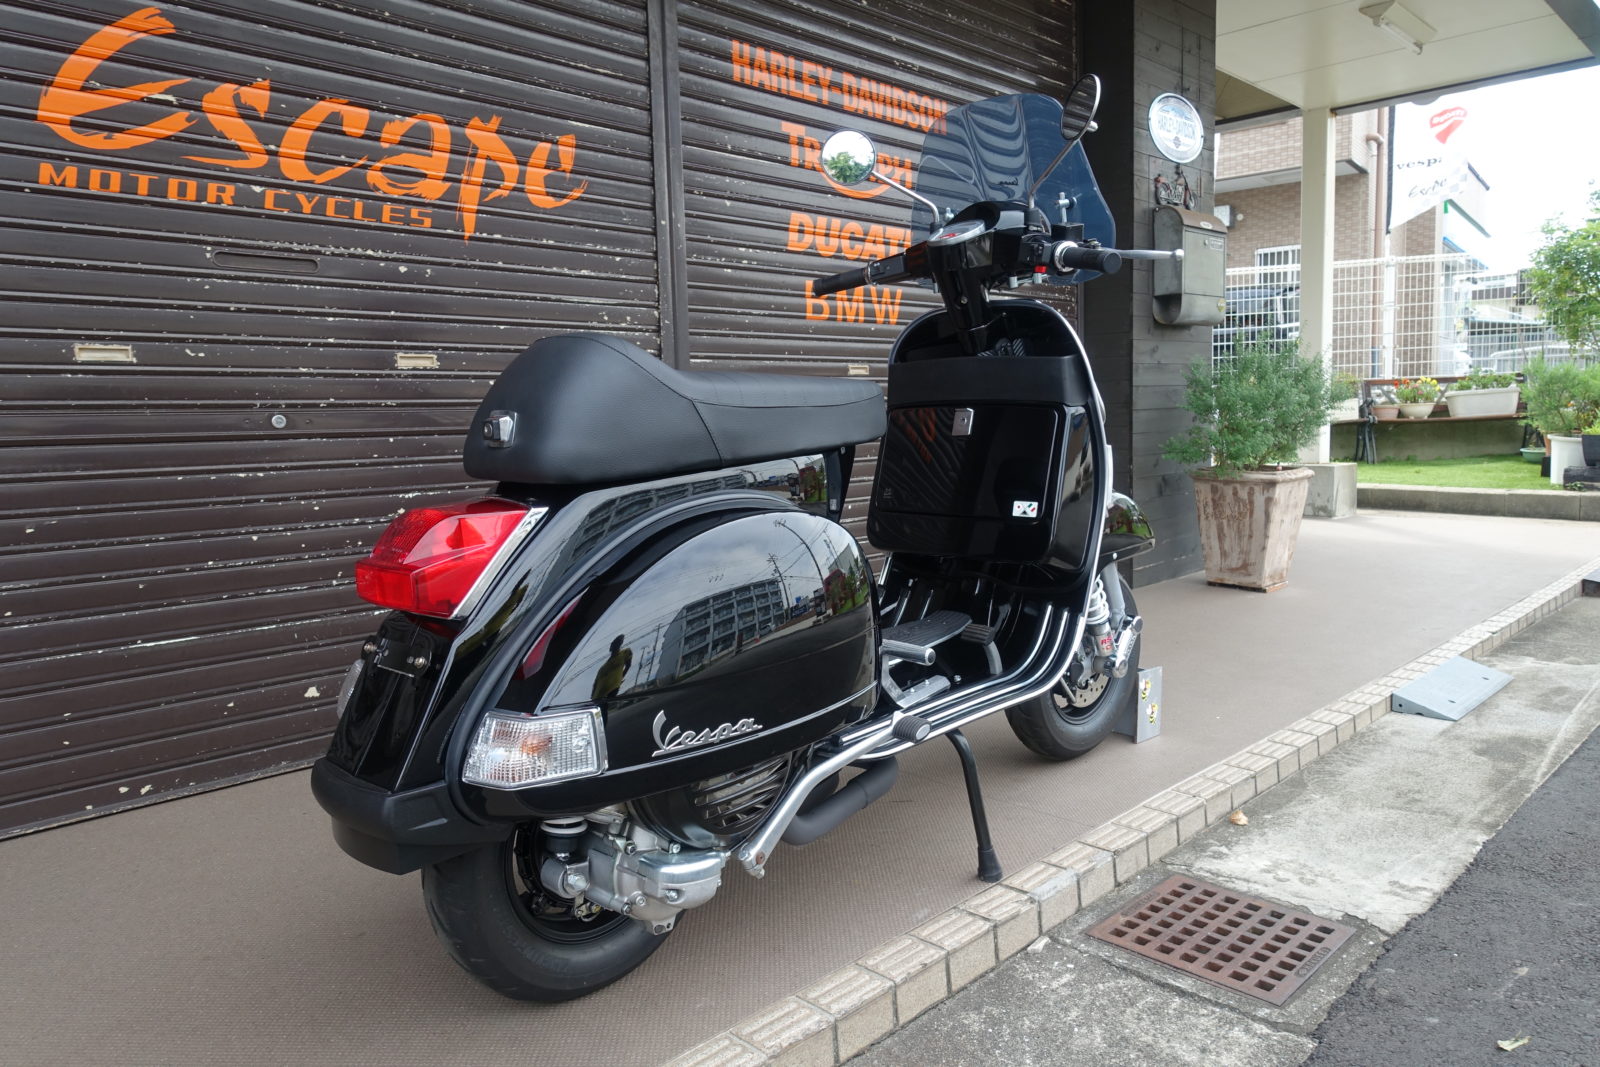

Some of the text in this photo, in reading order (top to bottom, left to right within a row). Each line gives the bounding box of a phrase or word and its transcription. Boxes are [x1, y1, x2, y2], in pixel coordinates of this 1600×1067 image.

[36, 7, 589, 245] Escape
[731, 40, 948, 136] HARLEY-DAVIDSON
[38, 162, 433, 229] MOTOR CYCLES
[780, 120, 913, 198] TRPH
[651, 709, 763, 757] Vespa
